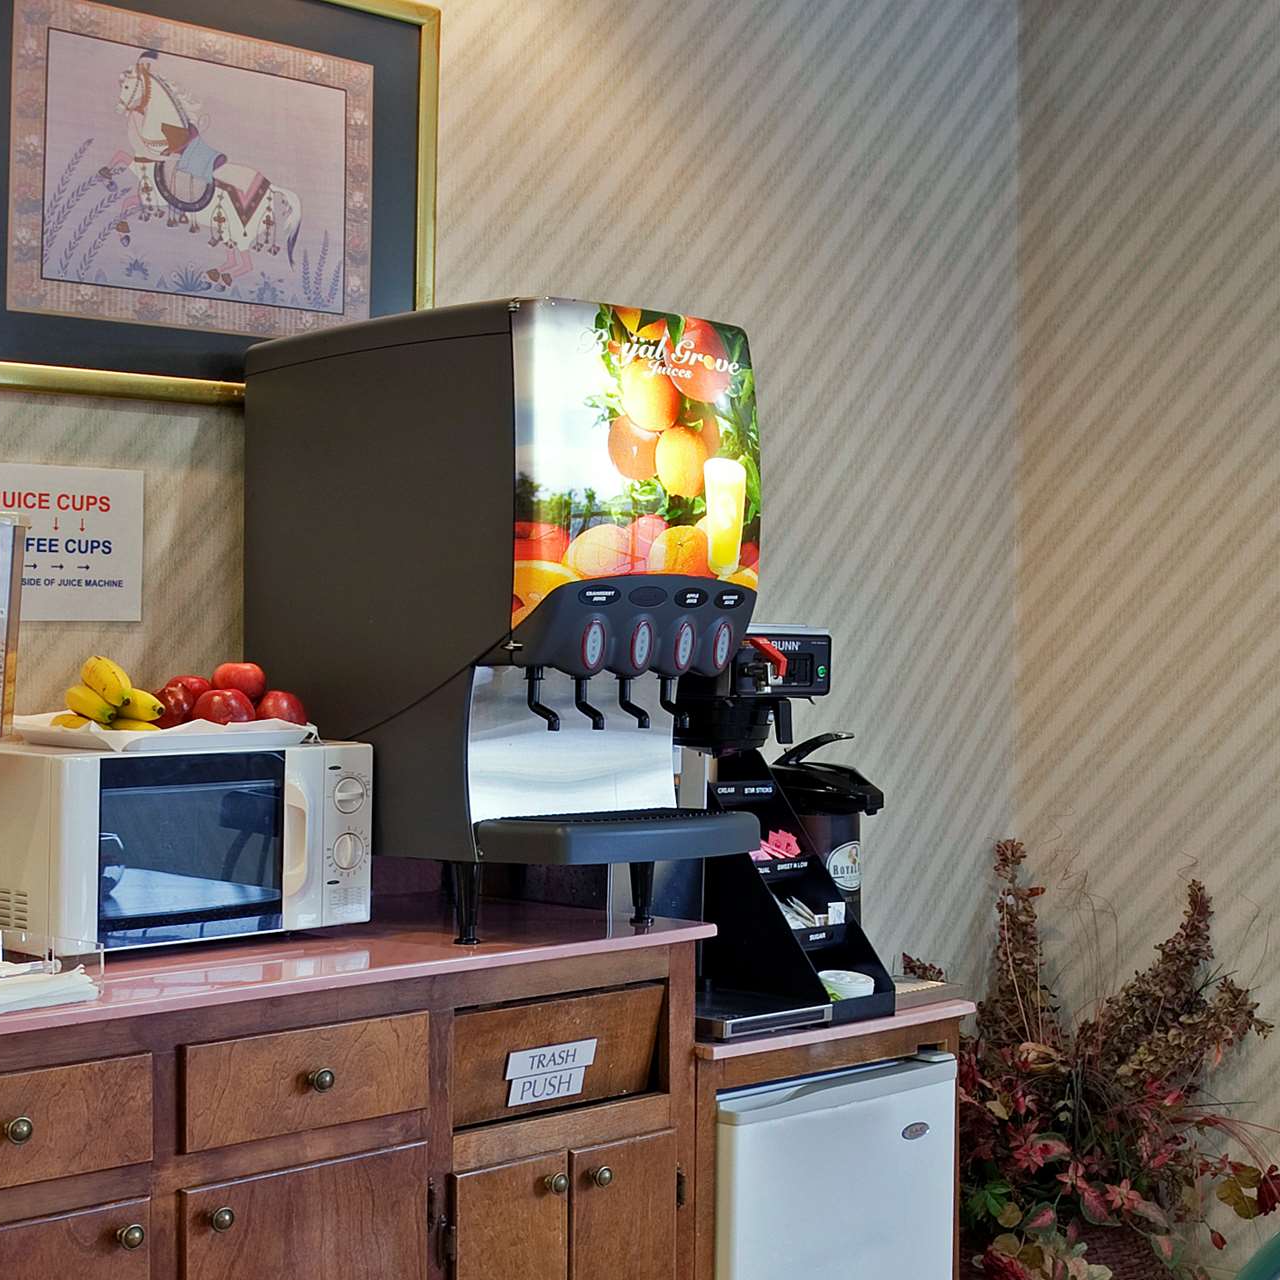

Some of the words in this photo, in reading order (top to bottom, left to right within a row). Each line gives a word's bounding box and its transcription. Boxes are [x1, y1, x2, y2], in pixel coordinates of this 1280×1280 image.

[670, 338, 741, 376] Grove
[644, 359, 694, 380] Juices
[56, 493, 112, 513] CUPS
[25, 537, 60, 554] FEE
[64, 538, 113, 556] CUPS
[21, 577, 42, 588] SIDE
[43, 578, 56, 588] OF
[58, 578, 83, 588] JUICE
[84, 579, 124, 589] MACHINE
[529, 1048, 577, 1070] TRASH
[520, 1073, 572, 1100] PUSH
